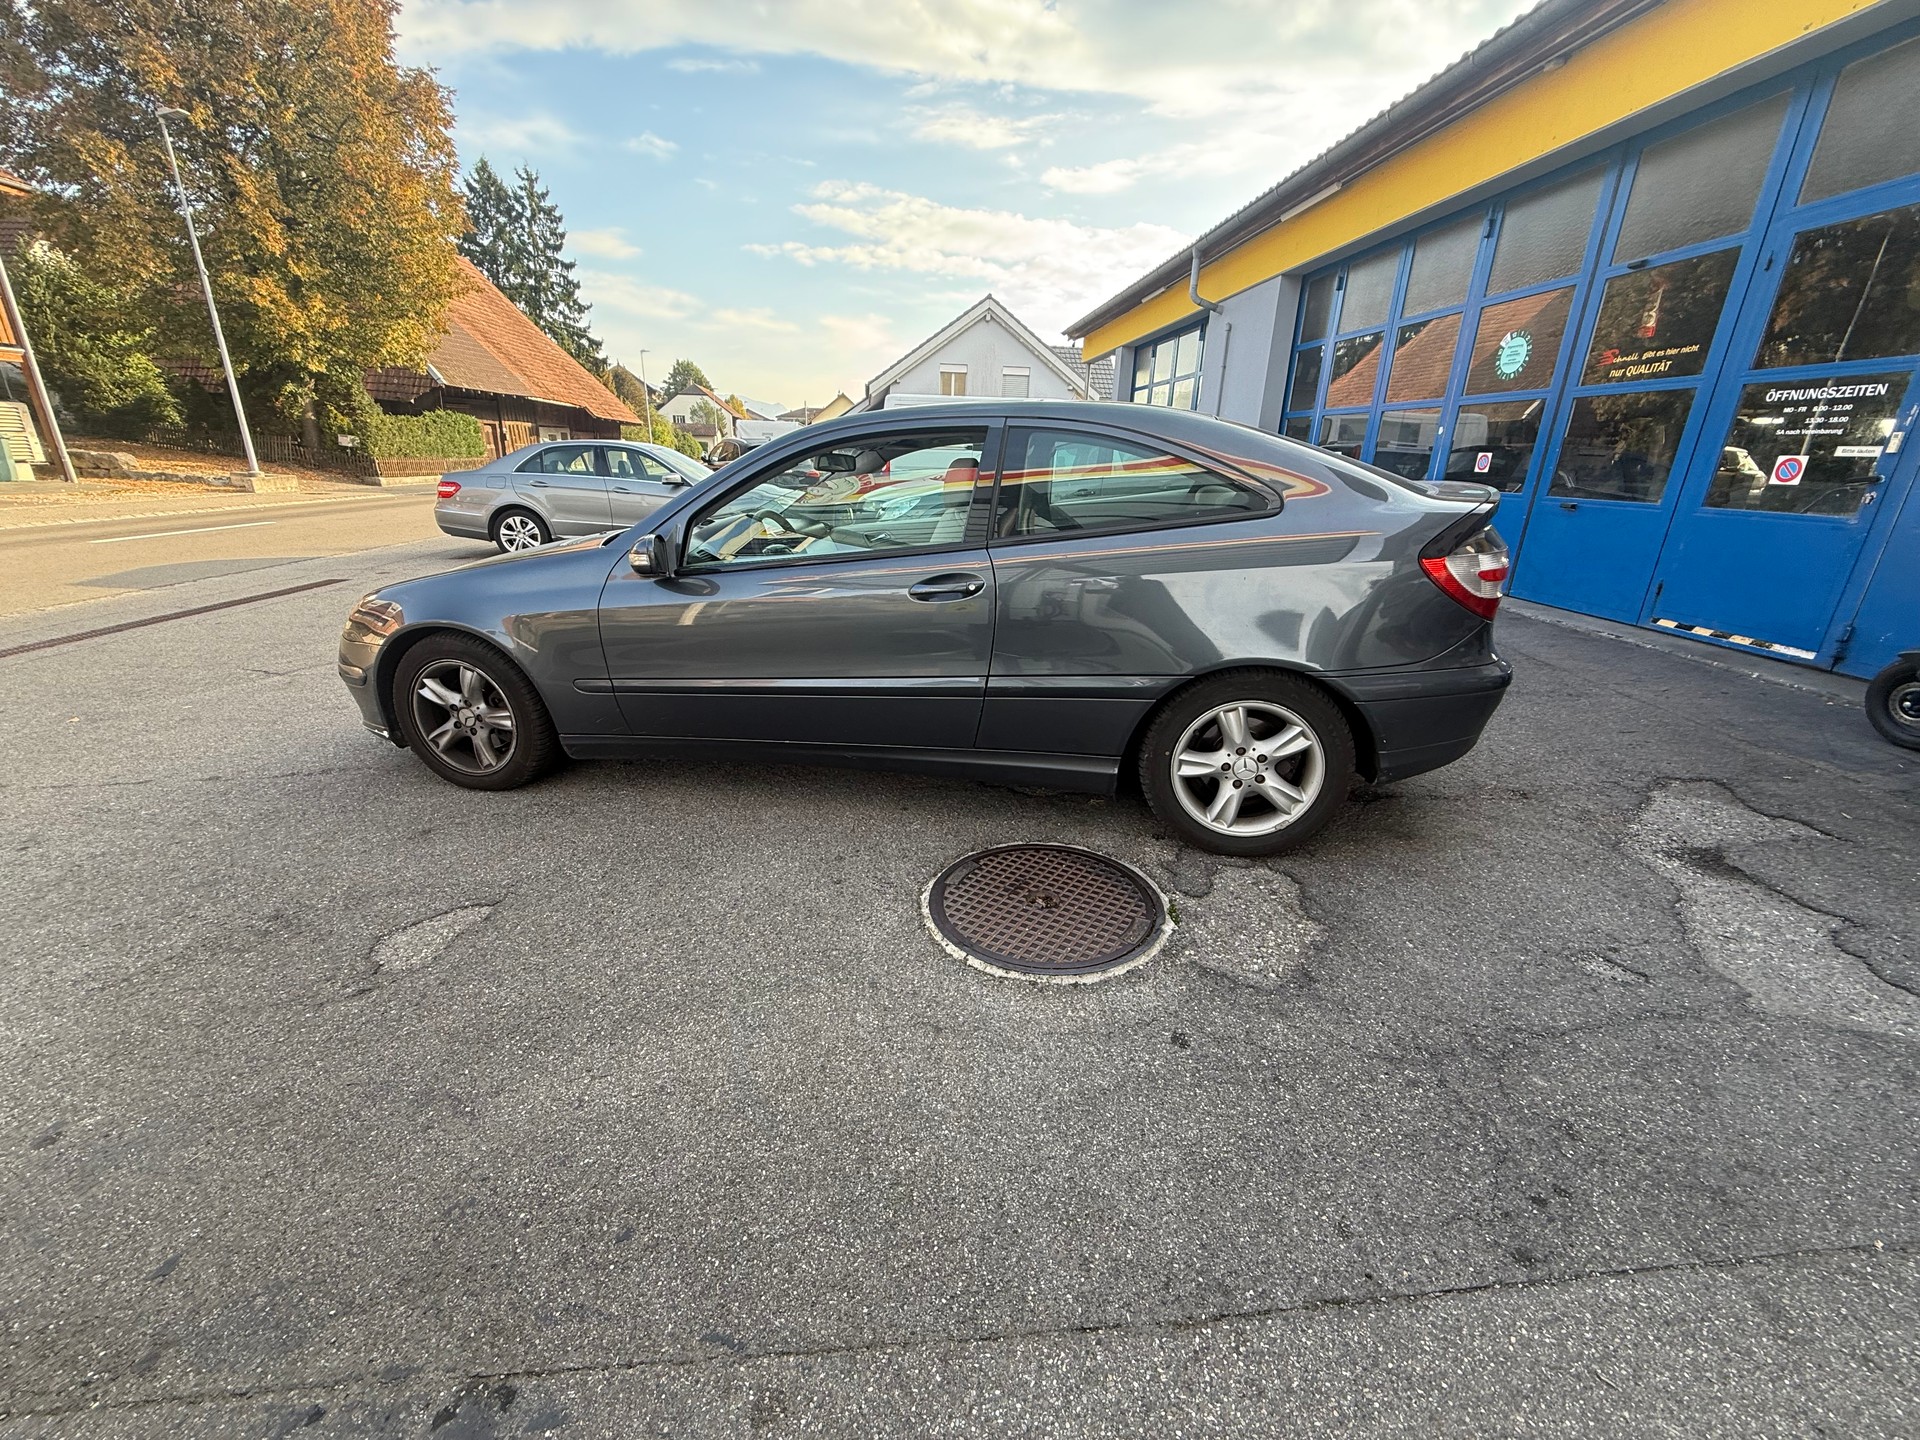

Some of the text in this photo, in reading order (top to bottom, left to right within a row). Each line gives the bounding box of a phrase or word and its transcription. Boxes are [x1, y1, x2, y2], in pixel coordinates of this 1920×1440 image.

[1597, 349, 1639, 366] Schnell
[1642, 351, 1656, 360] gibt
[1666, 347, 1681, 355] hier
[1680, 344, 1700, 354] nicht
[1609, 360, 1673, 378] nur QUALITÄT
[1765, 383, 1888, 402] ÖFFNUNGSZEITEN
[1801, 428, 1844, 436] Vereinbarung
